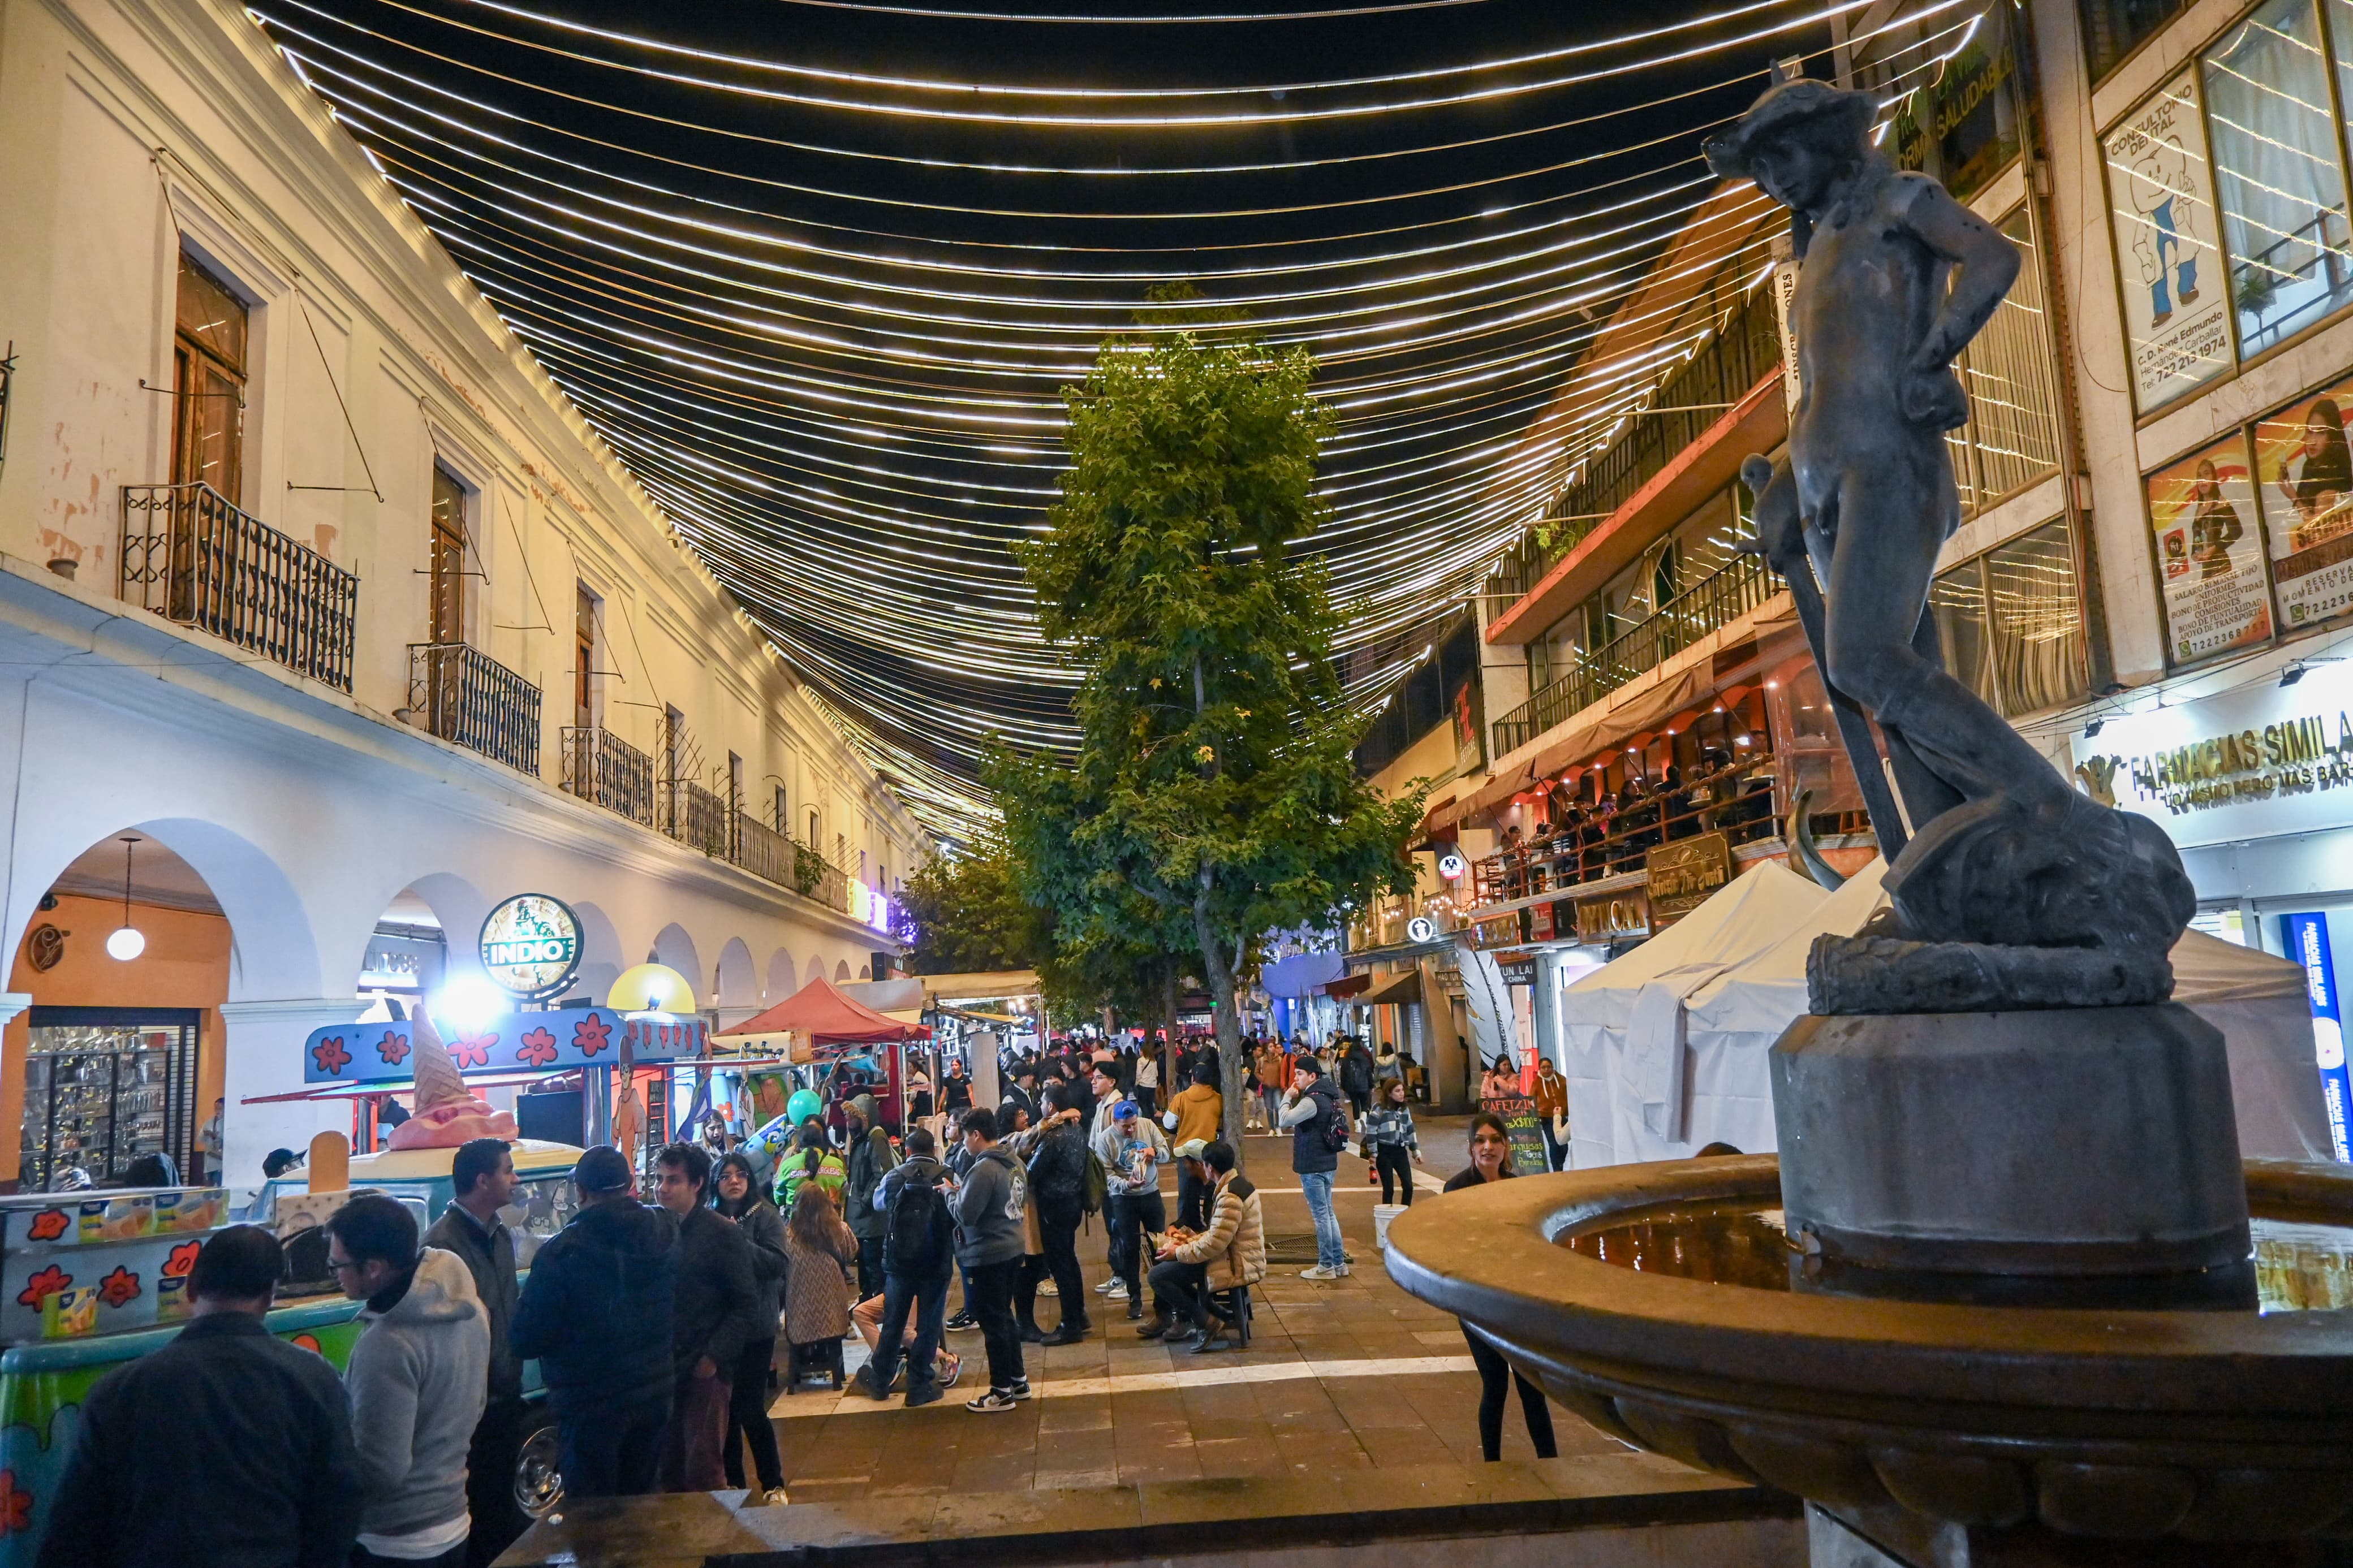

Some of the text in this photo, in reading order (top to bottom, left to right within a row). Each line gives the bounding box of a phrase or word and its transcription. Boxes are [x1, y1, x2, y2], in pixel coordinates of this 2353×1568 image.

[2111, 84, 2192, 156] CONSULTORIO
[2130, 115, 2176, 157] DENTAL
[2147, 350, 2157, 361] D.
[2179, 312, 2223, 340] Edmundo
[2184, 325, 2222, 351] Carballar
[2141, 335, 2227, 392] Tel: 722 213 1974
[2171, 580, 2265, 620] BONO DE PRODUCTIVIDAD
[2174, 584, 2204, 602] SALARIO
[2195, 580, 2236, 603] UNIFORMES
[2282, 579, 2335, 604] MOMENTO
[2178, 597, 2262, 634] BONO DE PUNTUALIDAD
[2194, 596, 2241, 619] COMISIONES
[2179, 607, 2263, 641] APOYO DE TRANSPORTE
[2131, 729, 2259, 792] FARMACIAS
[2278, 768, 2313, 788] MAS
[490, 939, 563, 965] INDIO
[1518, 964, 1533, 975] LAI
[818, 1166, 841, 1176] URGUESAS
